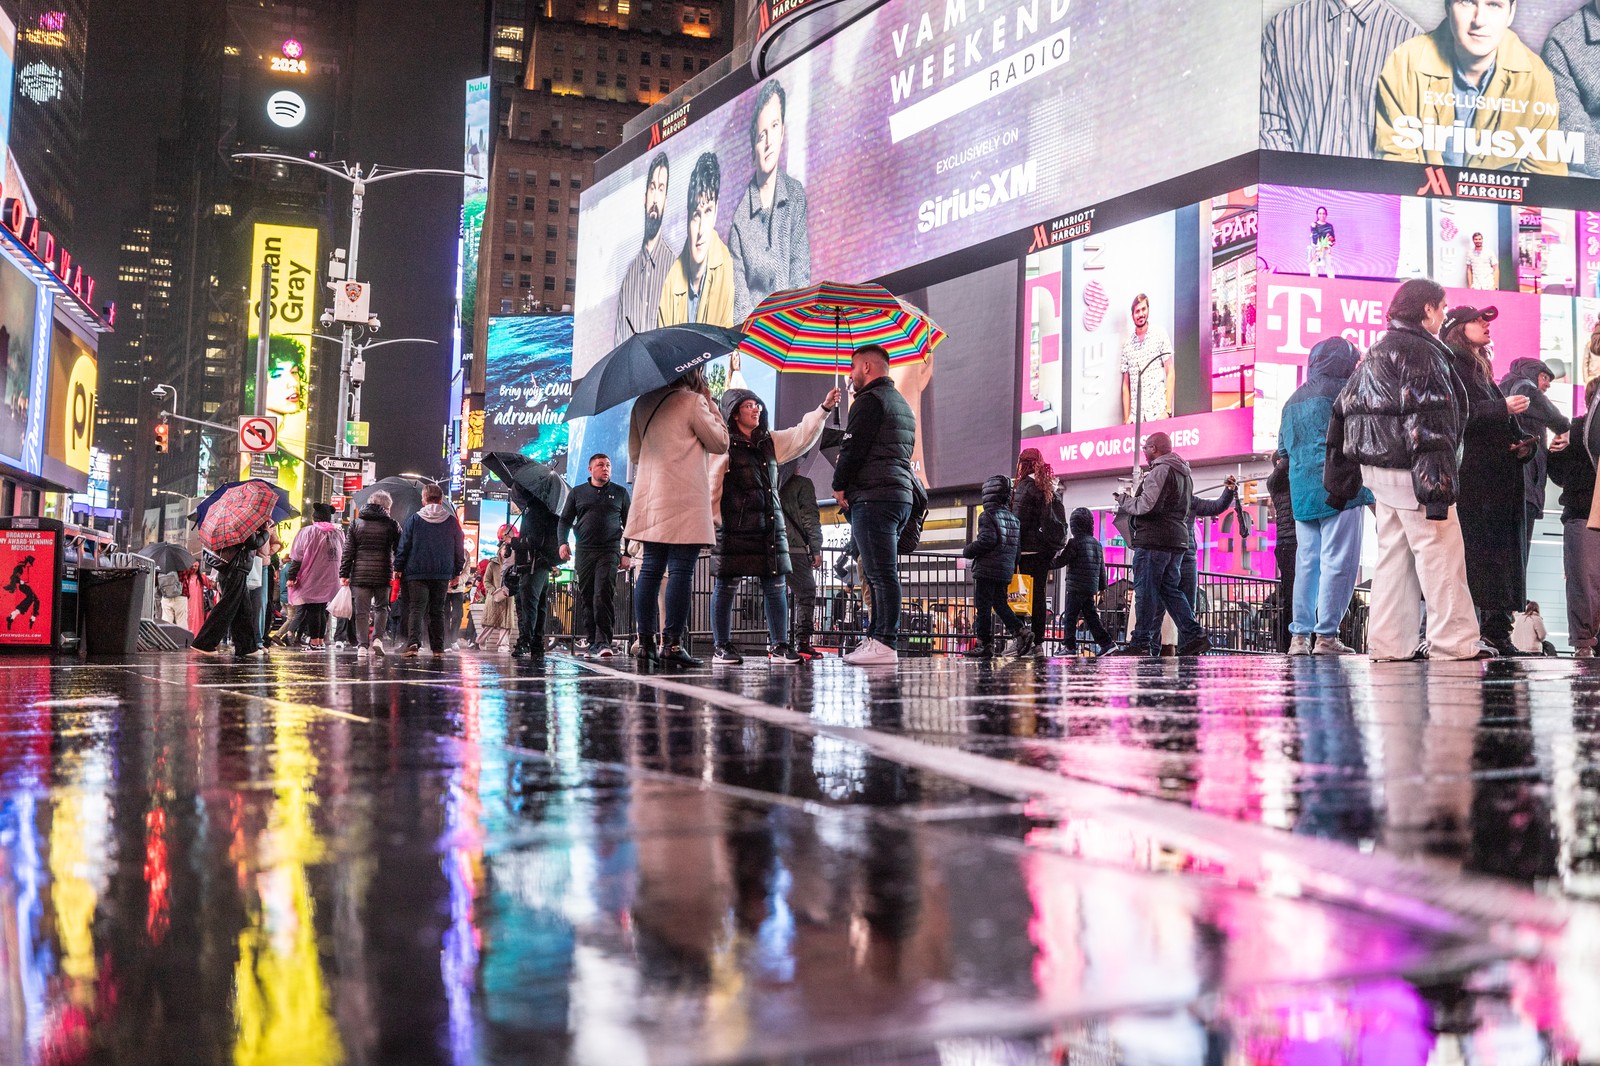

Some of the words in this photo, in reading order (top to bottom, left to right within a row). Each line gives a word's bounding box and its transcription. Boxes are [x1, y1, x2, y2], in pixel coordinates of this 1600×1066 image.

[890, 0, 1070, 104] WEEKEND
[270, 57, 307, 73] 2024
[989, 38, 1065, 91] RADIO
[468, 82, 488, 93] hulu
[1423, 90, 1529, 114] EXCLUSIVELY
[1533, 101, 1557, 116] ON
[662, 103, 691, 127] MARRIOTT
[662, 117, 687, 139] MARQUIS
[1391, 114, 1585, 165] SiriusXM
[936, 136, 1000, 174] EXCLUSIVELY
[1003, 128, 1019, 148] ON
[1459, 171, 1529, 187] MARRIOTT
[916, 158, 1037, 233] SiriusXM
[1458, 185, 1521, 200] MARQUIS
[1051, 208, 1096, 231] MARRIOTT
[0, 177, 98, 305] OADWAY
[1051, 222, 1091, 243] MARQUIS
[280, 260, 311, 323] Gray
[1340, 298, 1383, 325] WE
[674, 354, 704, 374] CHASE
[500, 384, 522, 401] Bring
[523, 386, 544, 400] your
[493, 404, 566, 425] adrenaline
[1059, 444, 1078, 462] WE
[1095, 438, 1121, 457] OUR
[322, 459, 337, 467] ONE
[5, 531, 41, 539] BROADWAY'S
